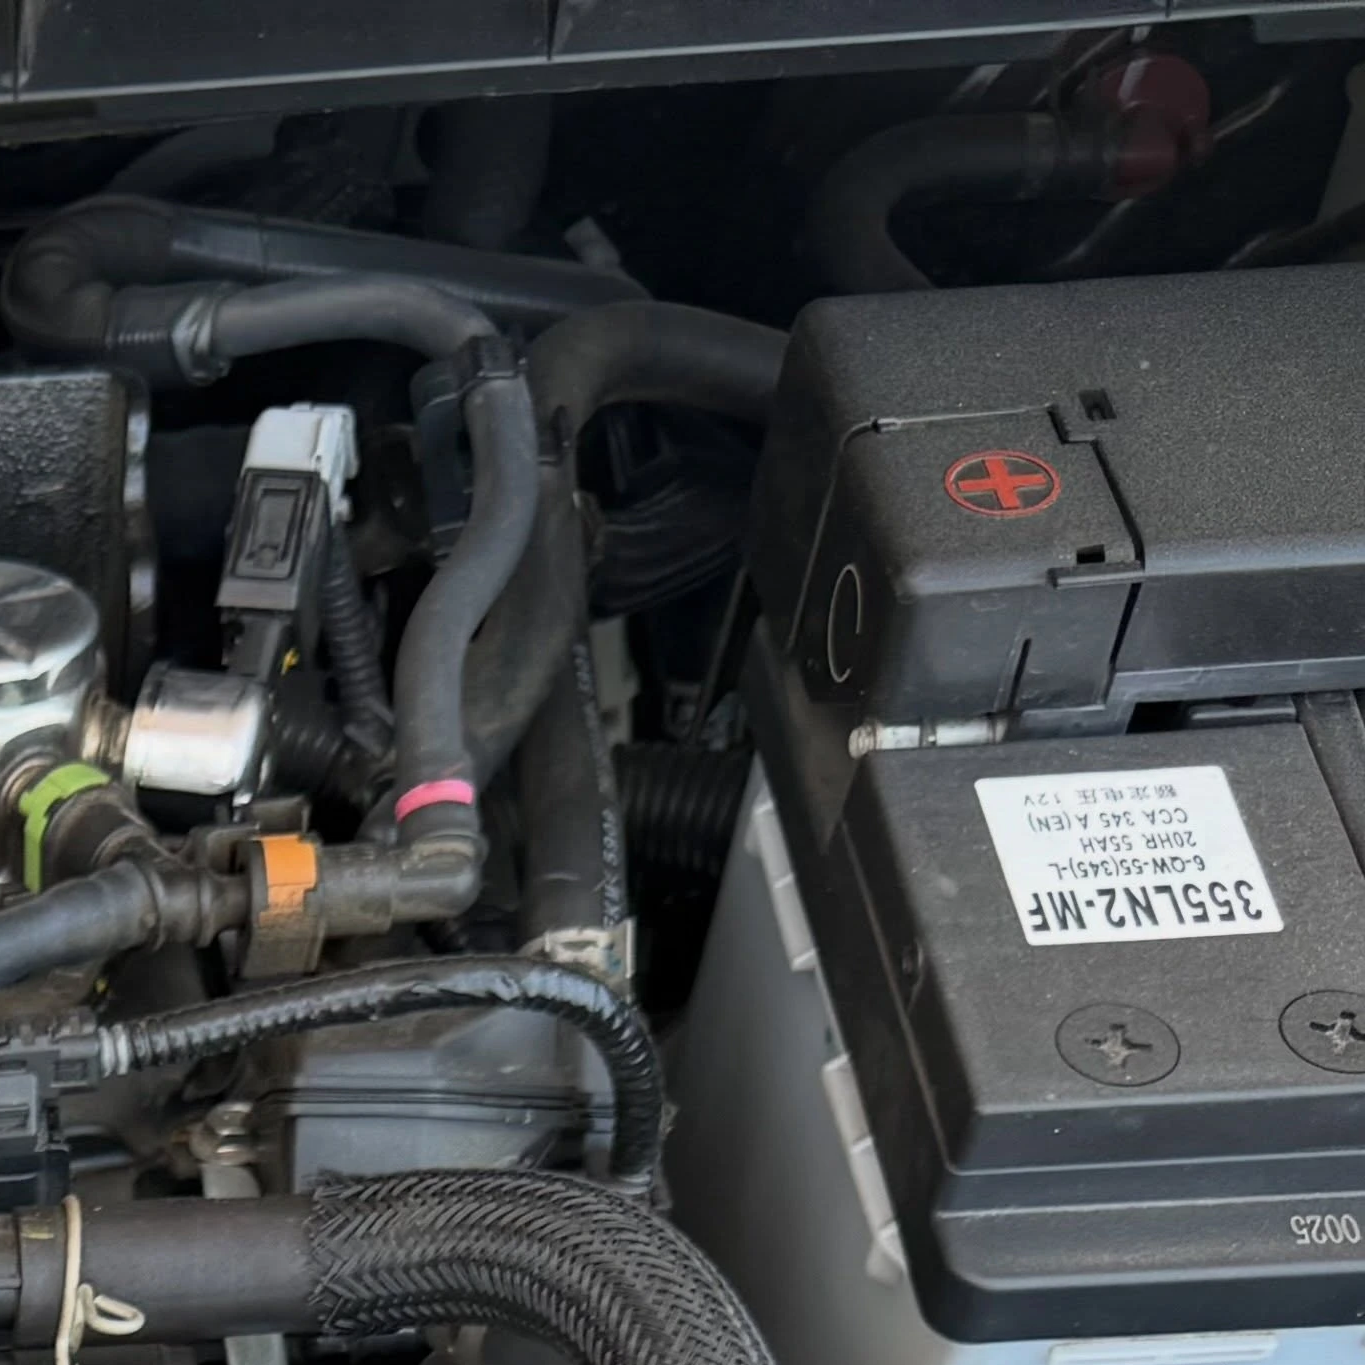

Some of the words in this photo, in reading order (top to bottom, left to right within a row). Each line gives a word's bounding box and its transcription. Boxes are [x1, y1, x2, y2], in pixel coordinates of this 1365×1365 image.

[1023, 792, 1062, 808] 12V
[1100, 811, 1135, 828] 345
[1142, 807, 1188, 825] CCA
[1079, 834, 1133, 854] 55AH
[1145, 830, 1197, 850] 20HR
[1048, 854, 1206, 881] 6-QW-55(345)-L
[1027, 879, 1263, 933] 355LN2-MF
[1290, 1213, 1361, 1245] 0025
